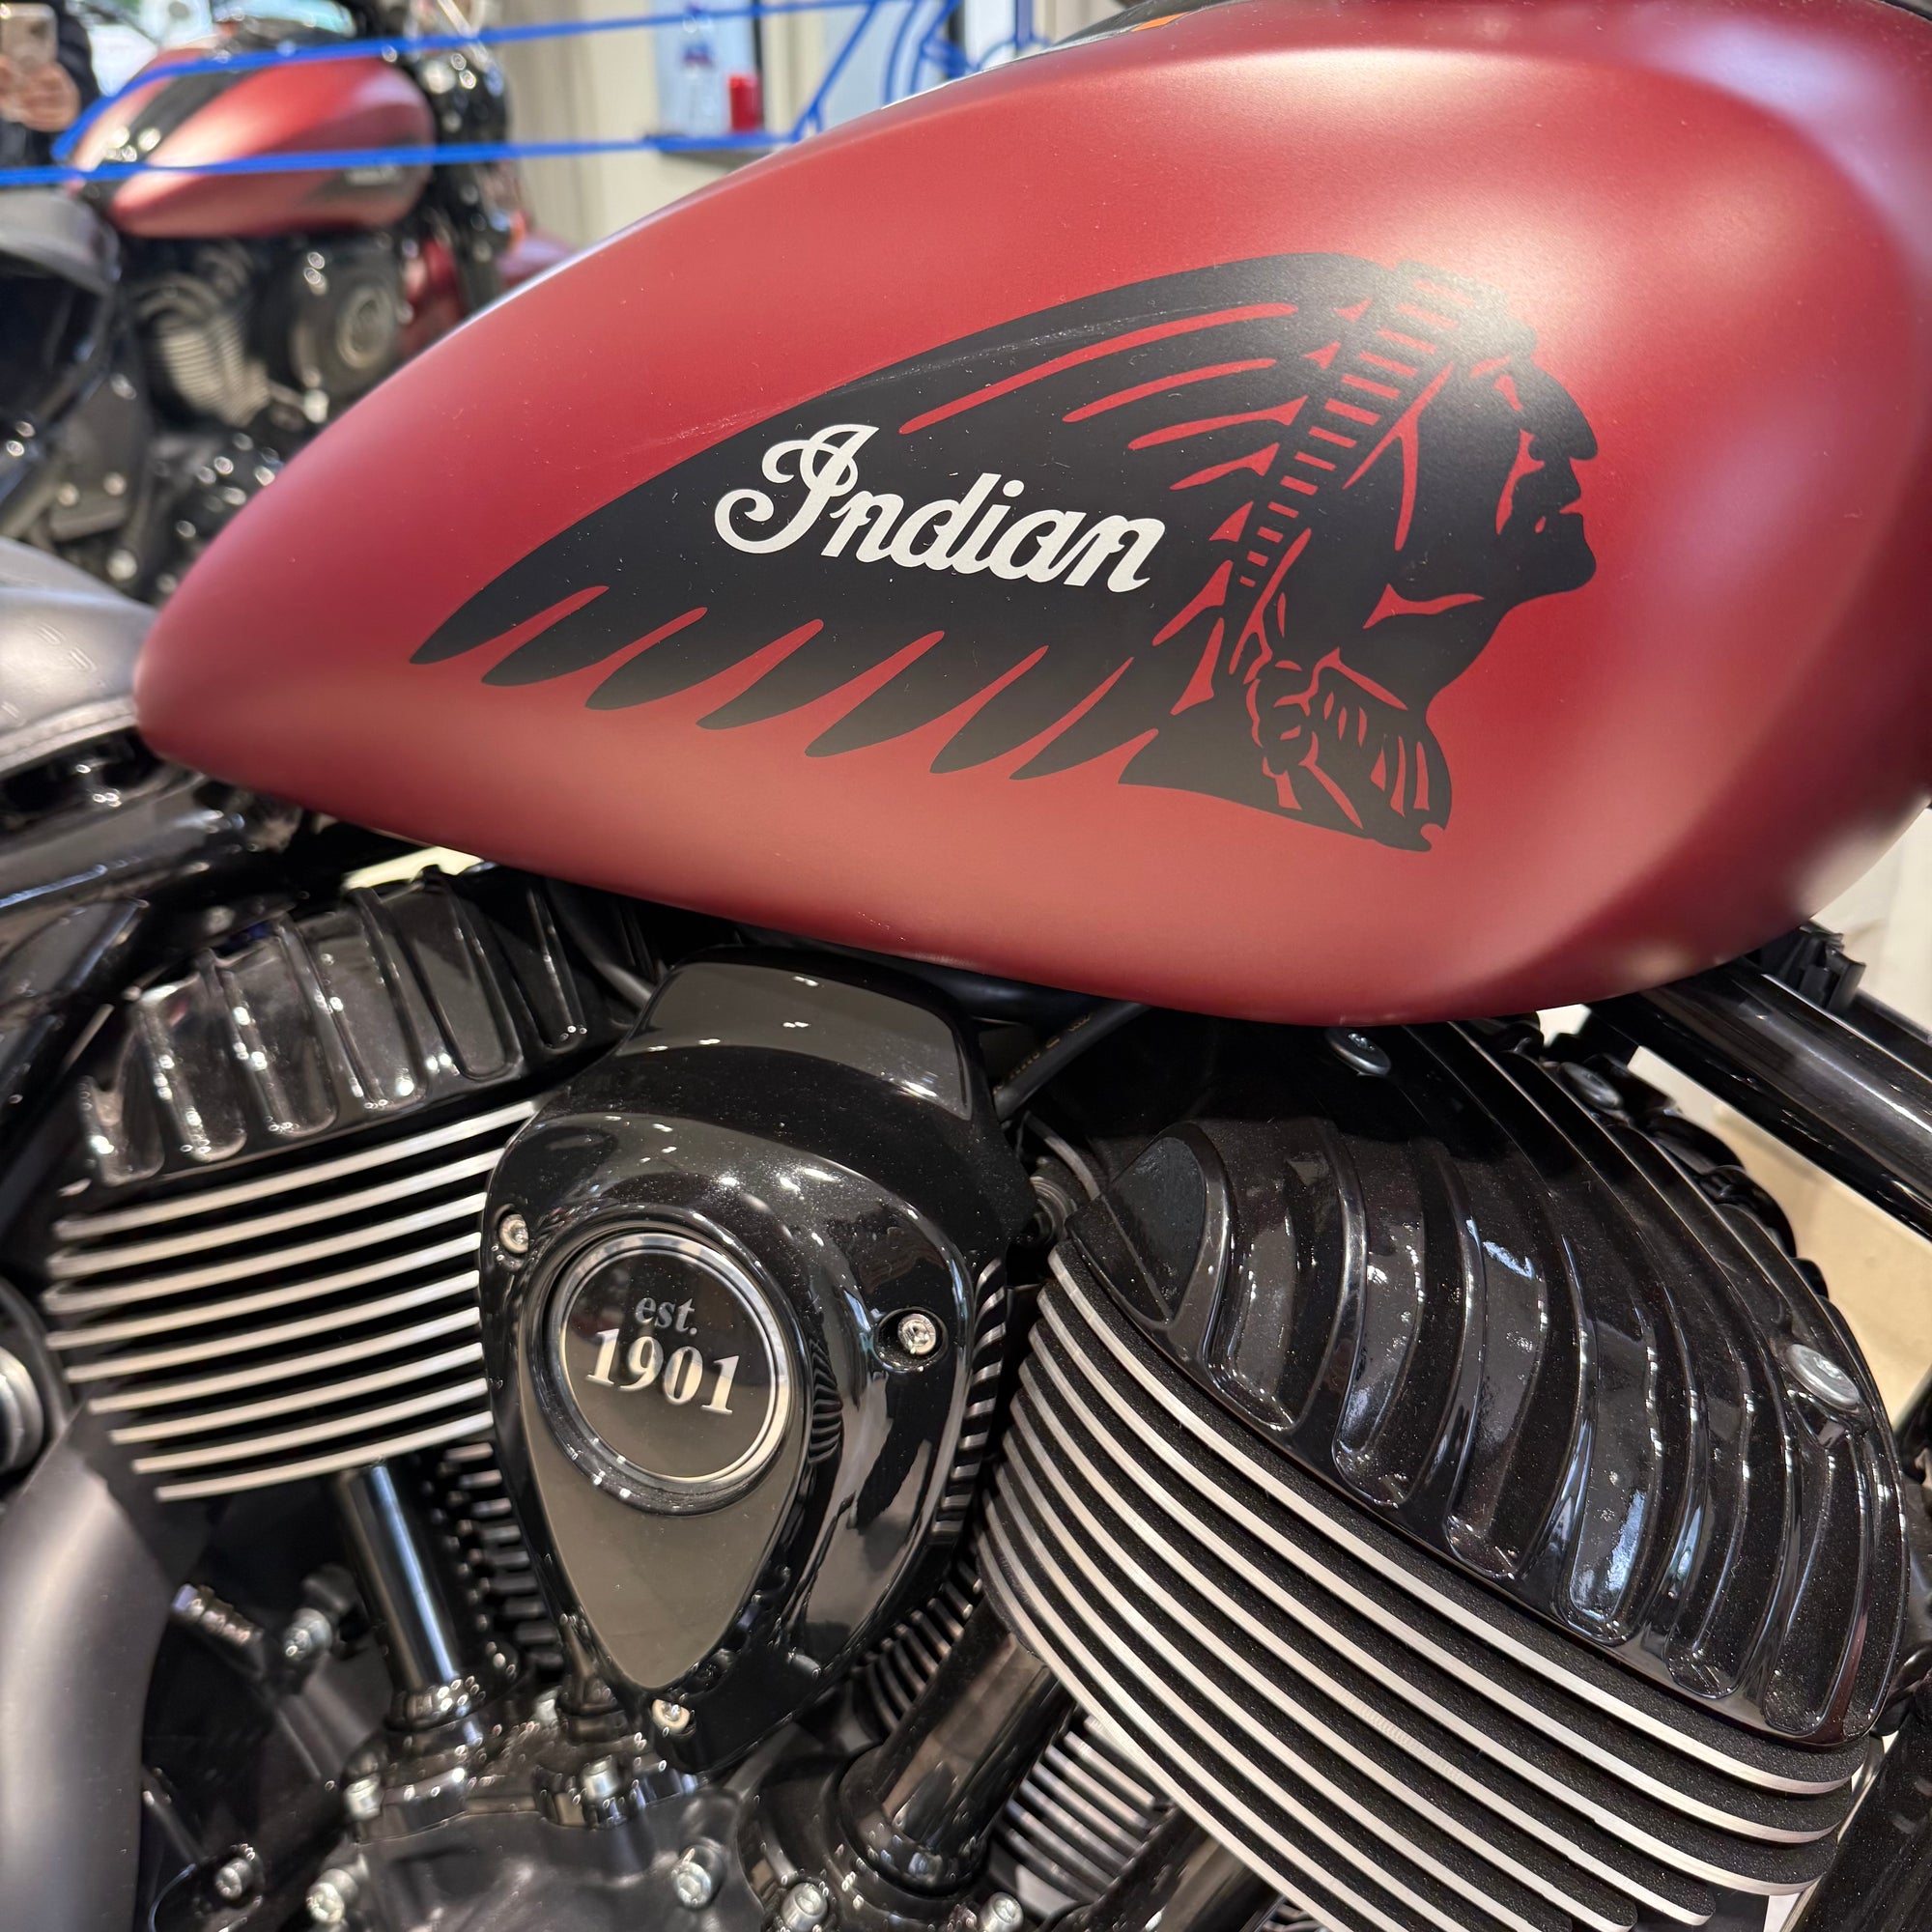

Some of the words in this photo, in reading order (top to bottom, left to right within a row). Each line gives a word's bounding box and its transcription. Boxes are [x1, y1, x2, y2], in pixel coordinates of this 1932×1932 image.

[714, 423, 1166, 593] Indian
[635, 1296, 698, 1336] est.
[585, 1327, 740, 1415] 1901
